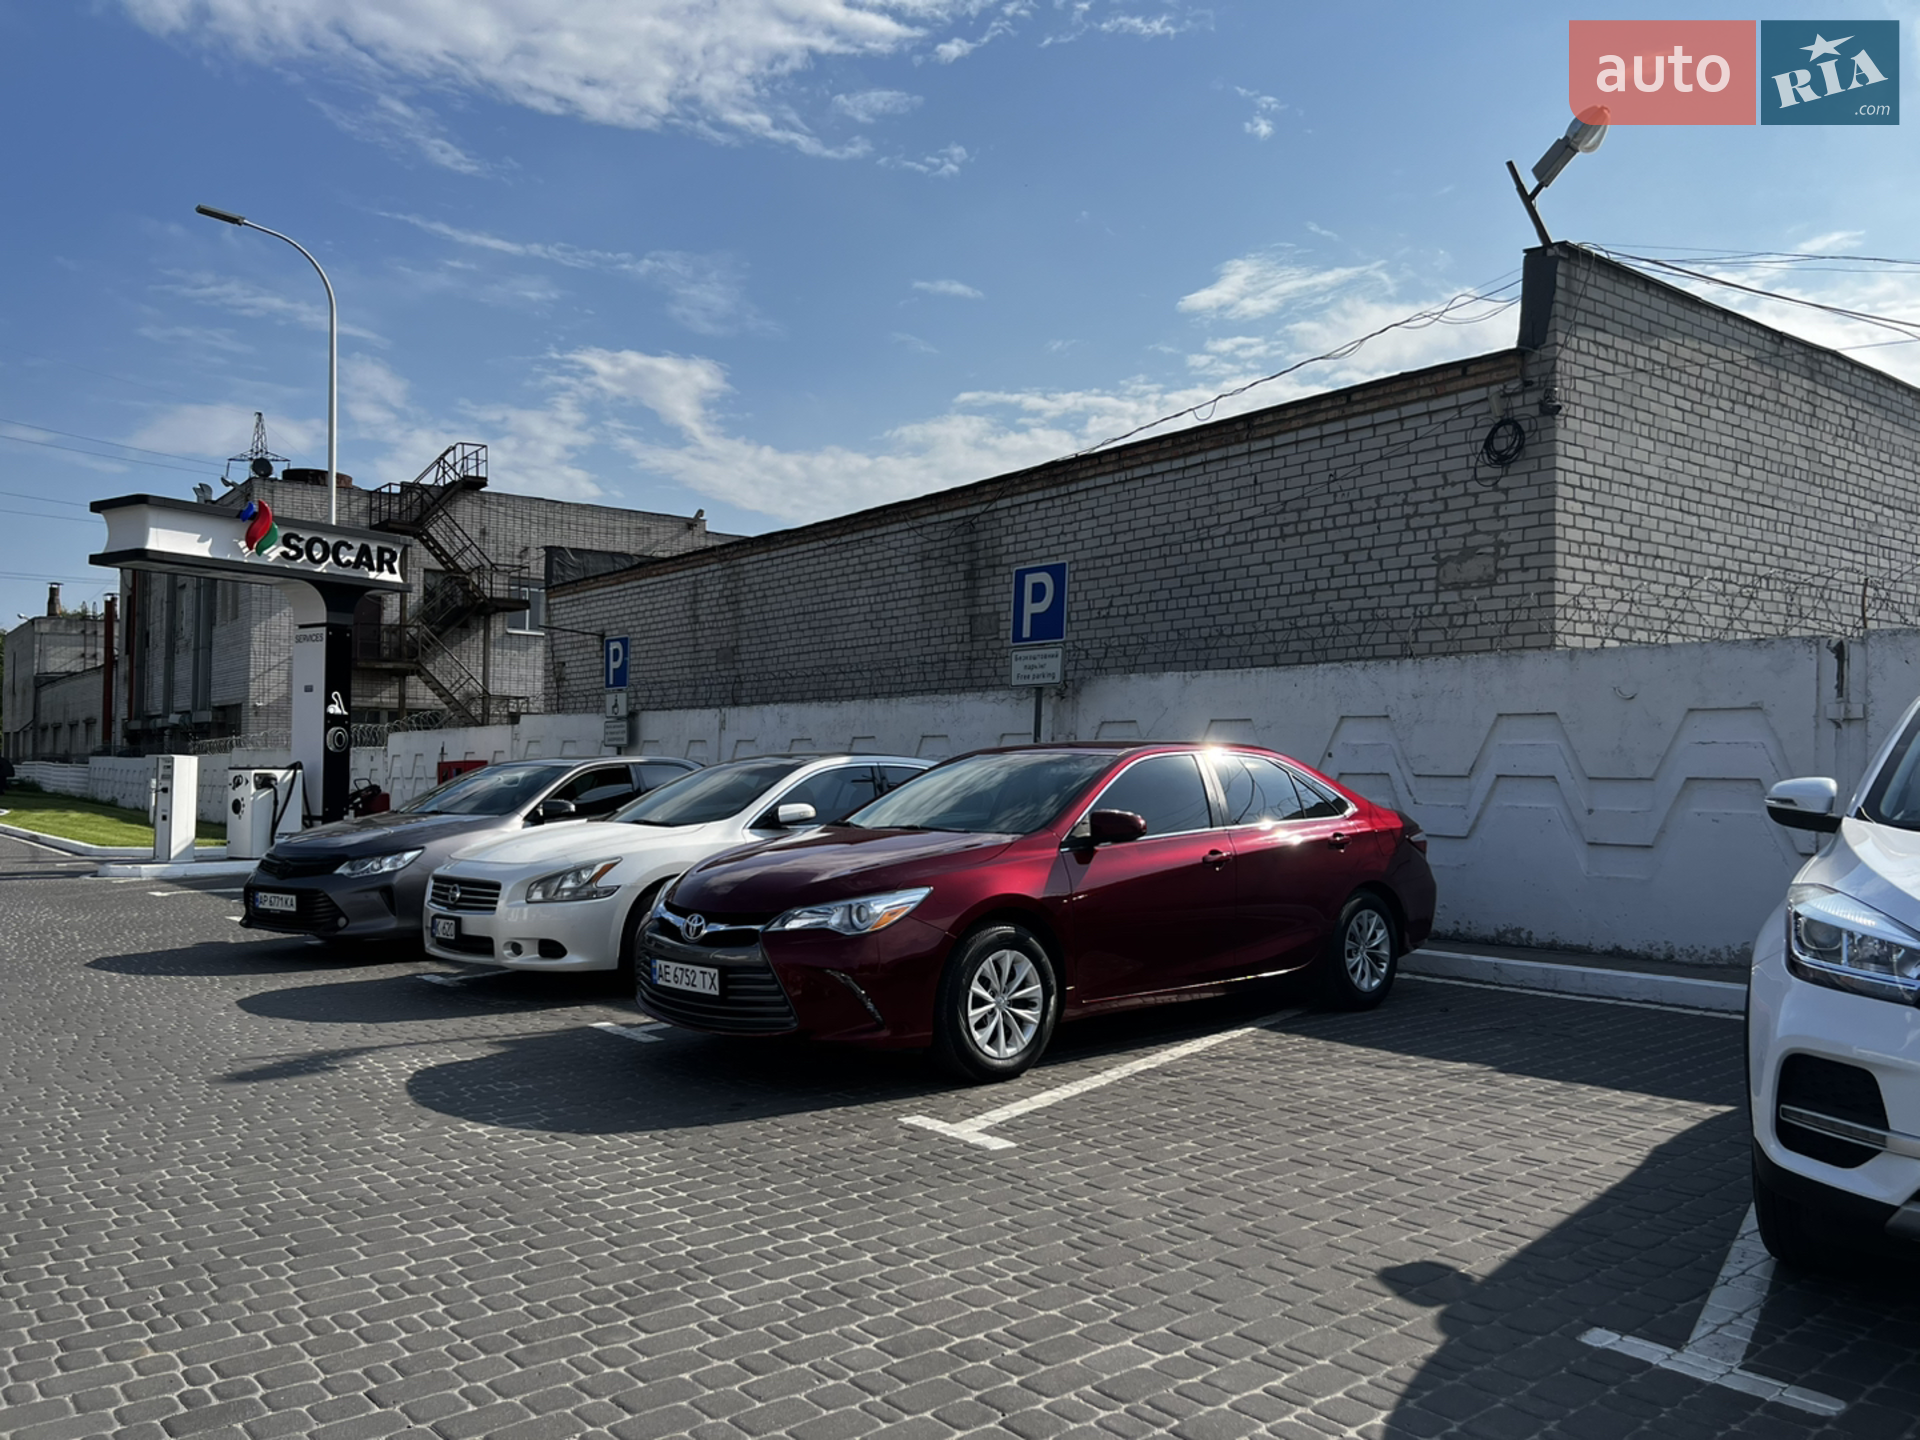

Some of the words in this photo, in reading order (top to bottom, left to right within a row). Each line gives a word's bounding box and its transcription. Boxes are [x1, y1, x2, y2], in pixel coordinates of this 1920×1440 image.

[280, 532, 398, 575] SOCAR
[1022, 572, 1054, 638] P
[294, 632, 324, 644] SERVICES
[609, 641, 624, 685] P
[1016, 672, 1031, 681] Free
[1031, 671, 1056, 681] parking
[658, 964, 671, 983] AE
[673, 967, 697, 987] 6752
[699, 970, 717, 991] TX
